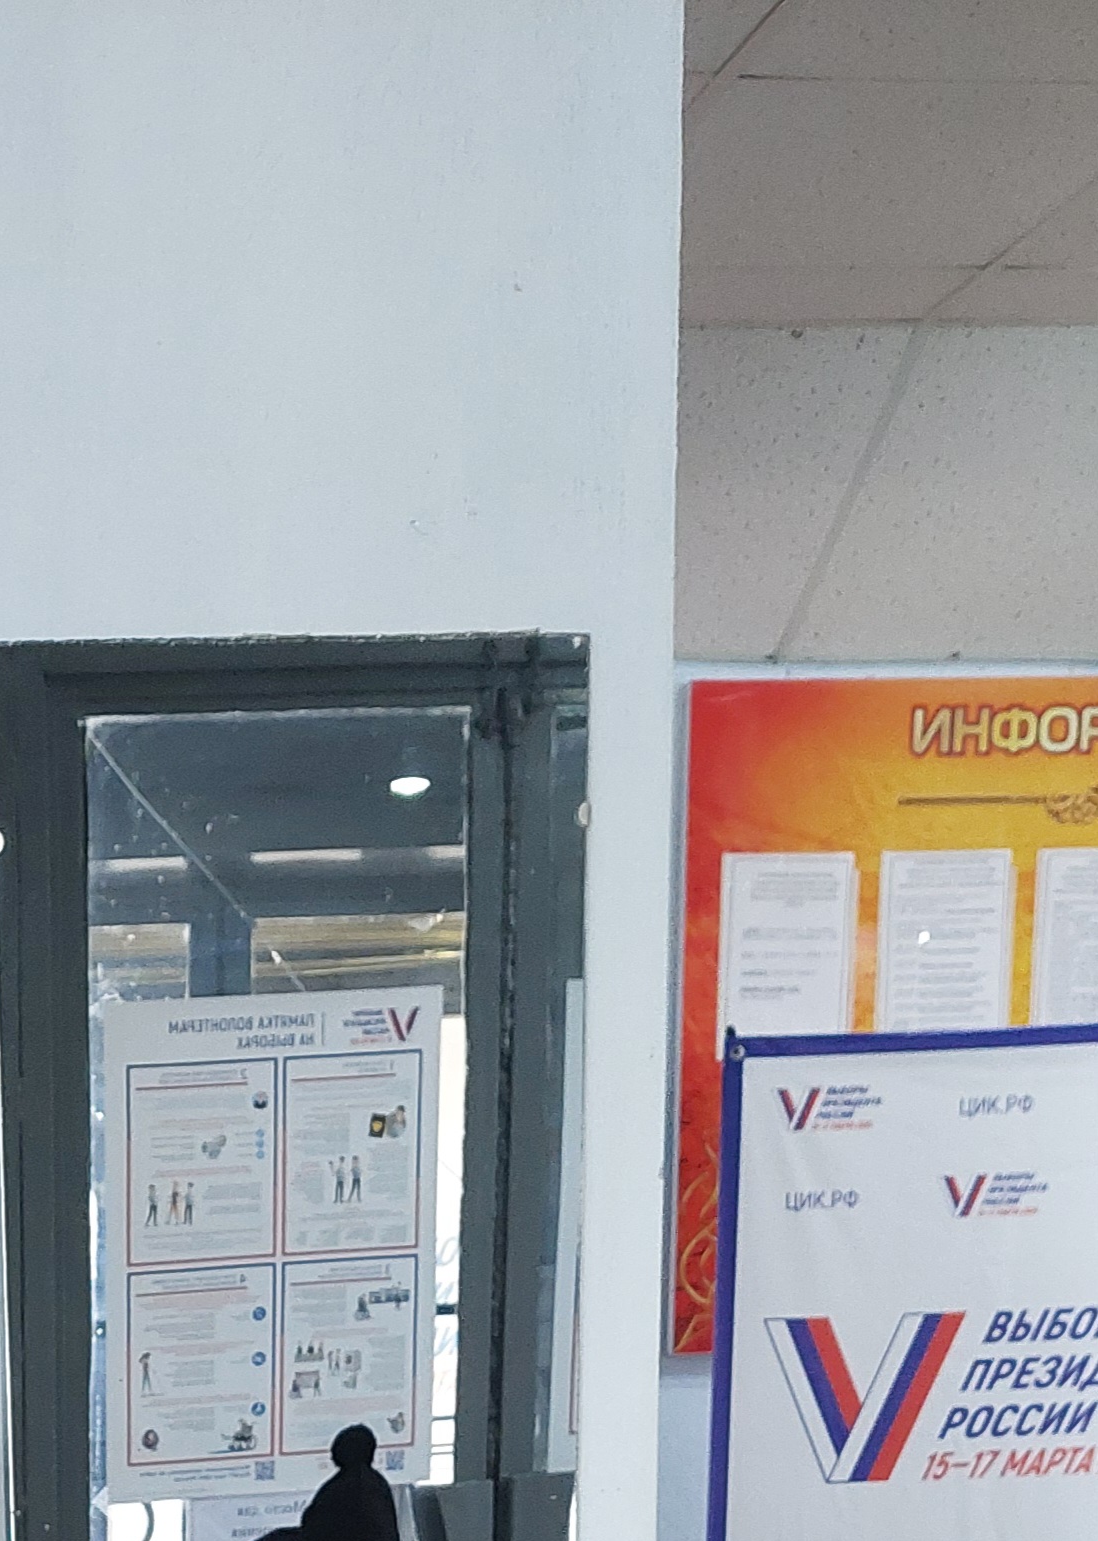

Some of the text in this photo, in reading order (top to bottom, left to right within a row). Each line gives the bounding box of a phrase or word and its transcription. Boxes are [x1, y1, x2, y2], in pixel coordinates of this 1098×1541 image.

[958, 1093, 1035, 1118] ЦИК.РФ
[784, 1189, 860, 1212] ЦИК.РФ
[981, 1306, 1098, 1344] ВЫБО
[936, 1401, 1098, 1440] РОССИИ
[1000, 1445, 1096, 1478] МАРТА
